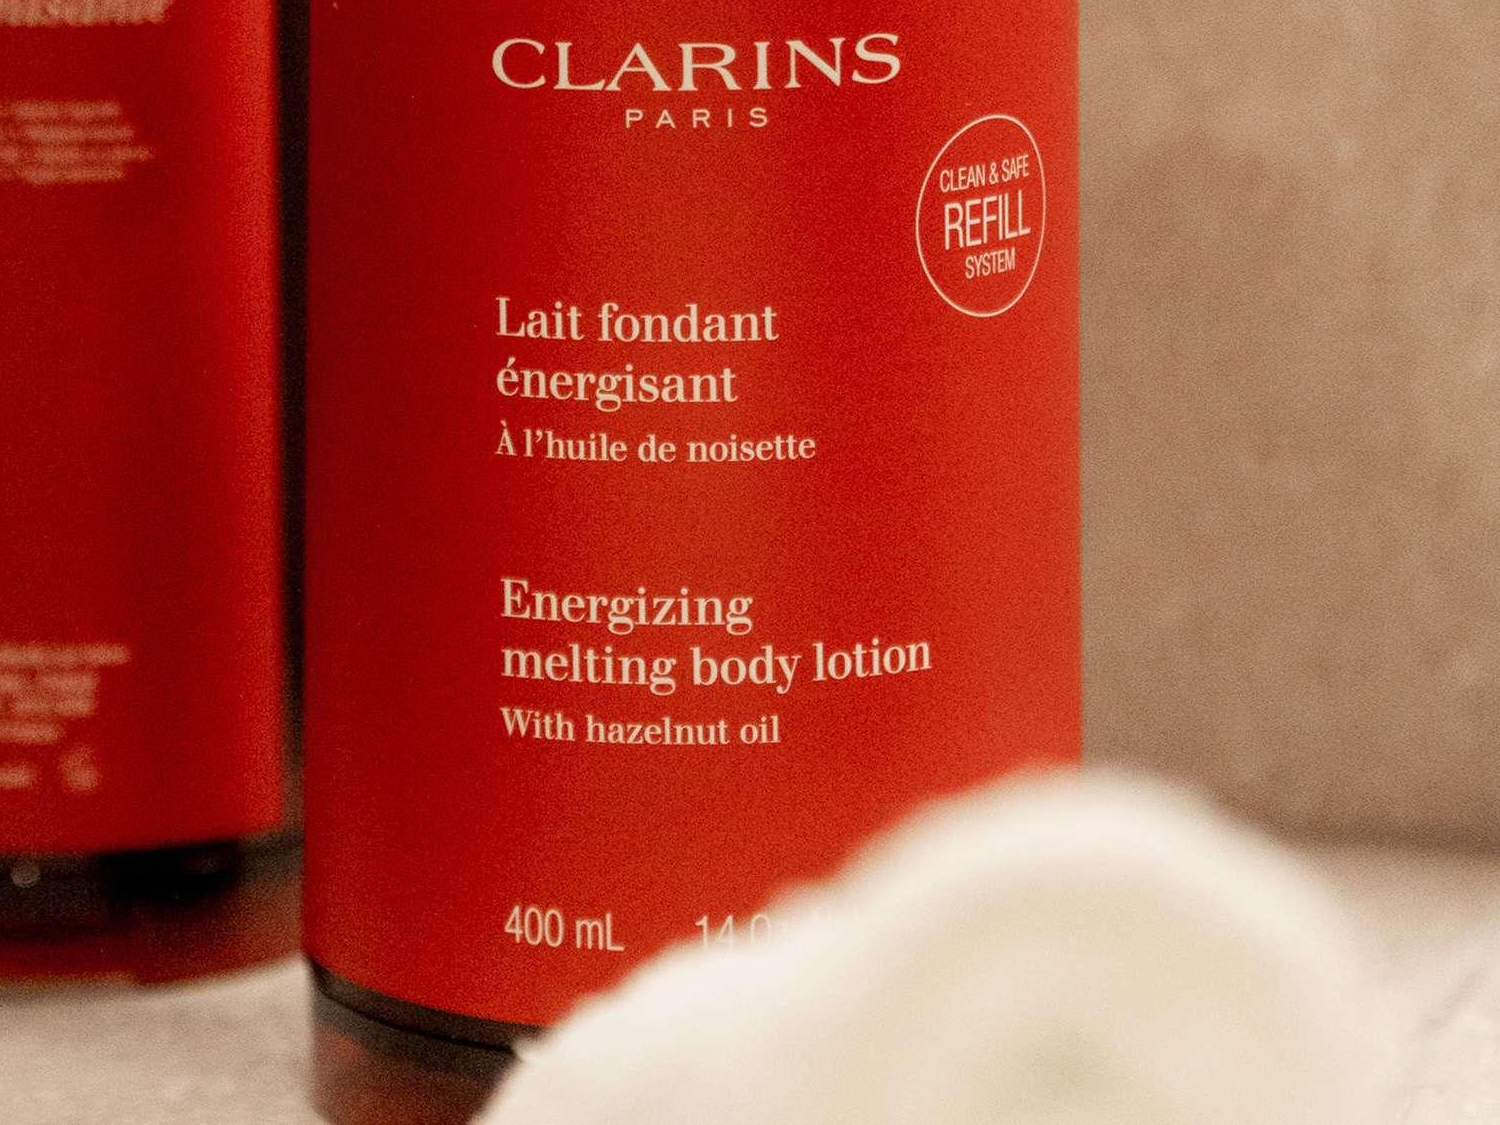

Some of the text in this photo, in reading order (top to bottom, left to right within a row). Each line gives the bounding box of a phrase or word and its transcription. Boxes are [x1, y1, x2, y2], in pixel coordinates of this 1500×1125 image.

[491, 32, 902, 92] CLARINS
[624, 106, 769, 129] PARIS
[939, 154, 1030, 193] CLEAN & SAFE
[944, 189, 1031, 251] REFILL
[965, 247, 1017, 279] SYSTEM
[496, 296, 779, 343] Lait fondant
[496, 356, 738, 413] énergisant
[496, 420, 516, 457] À
[638, 433, 677, 463] de
[687, 433, 816, 463] noisette
[501, 577, 753, 636] Energizing
[502, 637, 932, 697] melting body lotion
[501, 706, 780, 746] With hazelnut oil
[504, 904, 565, 949] 400
[575, 911, 626, 952] mL
